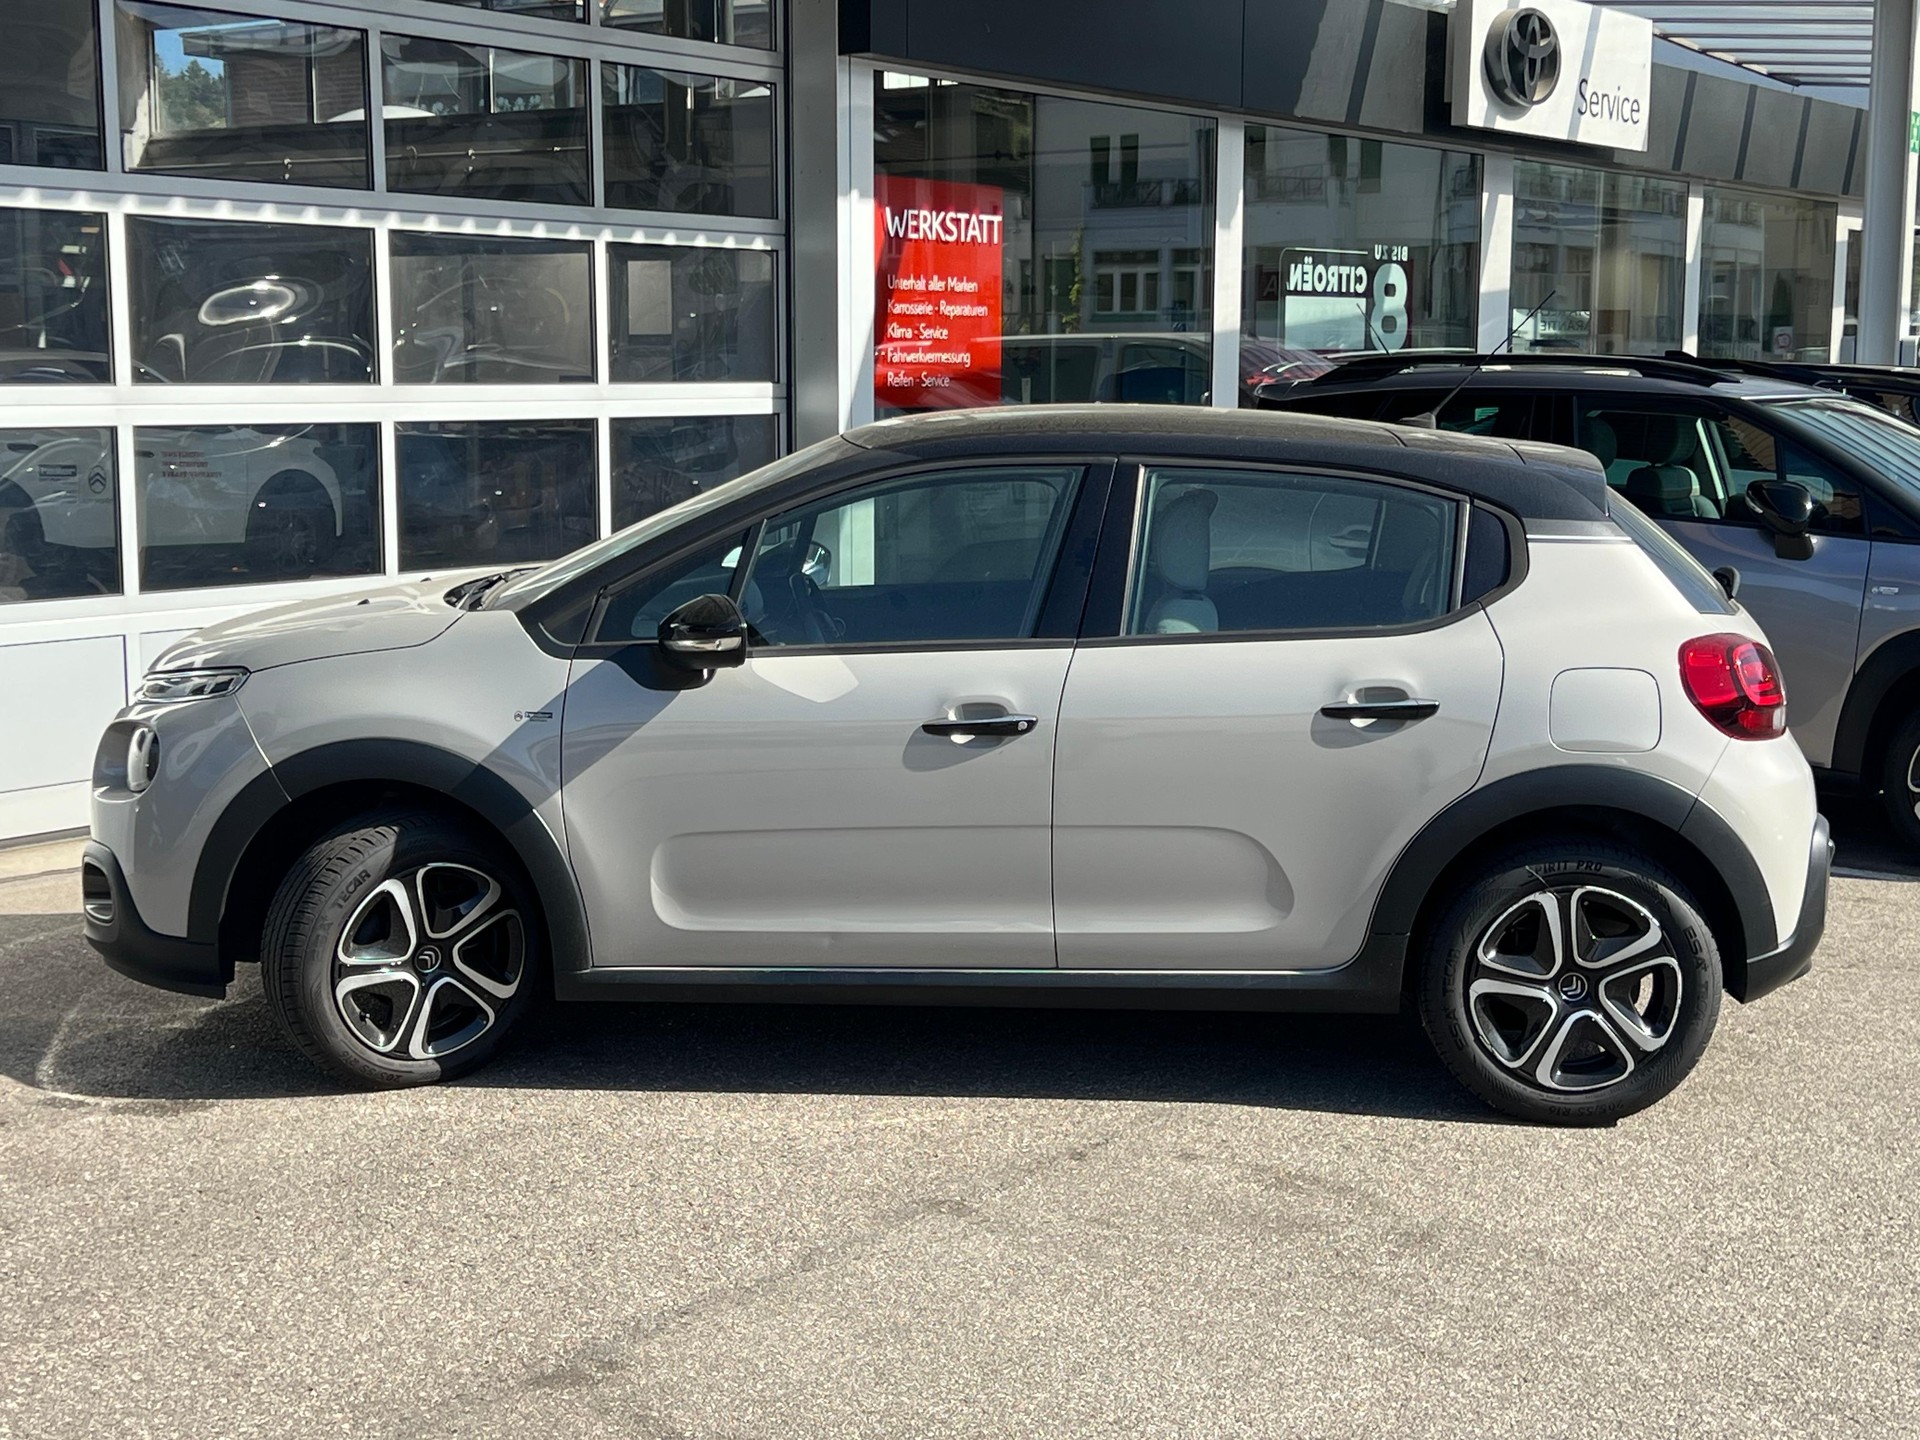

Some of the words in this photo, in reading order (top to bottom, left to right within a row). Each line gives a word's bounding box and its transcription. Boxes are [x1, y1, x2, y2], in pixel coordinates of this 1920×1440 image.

[1578, 78, 1640, 125] Service
[886, 207, 1003, 243] WERKSTATT
[887, 274, 926, 291] Unterhalt
[928, 275, 946, 292] aller
[947, 276, 978, 293] Marken
[939, 300, 989, 319] Reparaturen
[887, 322, 913, 339] Klima
[919, 323, 949, 340] Service
[887, 347, 971, 368] Fahrwerkvermessung
[887, 370, 914, 387] Reifen
[921, 371, 950, 388] Service
[1575, 859, 1603, 873] PRO
